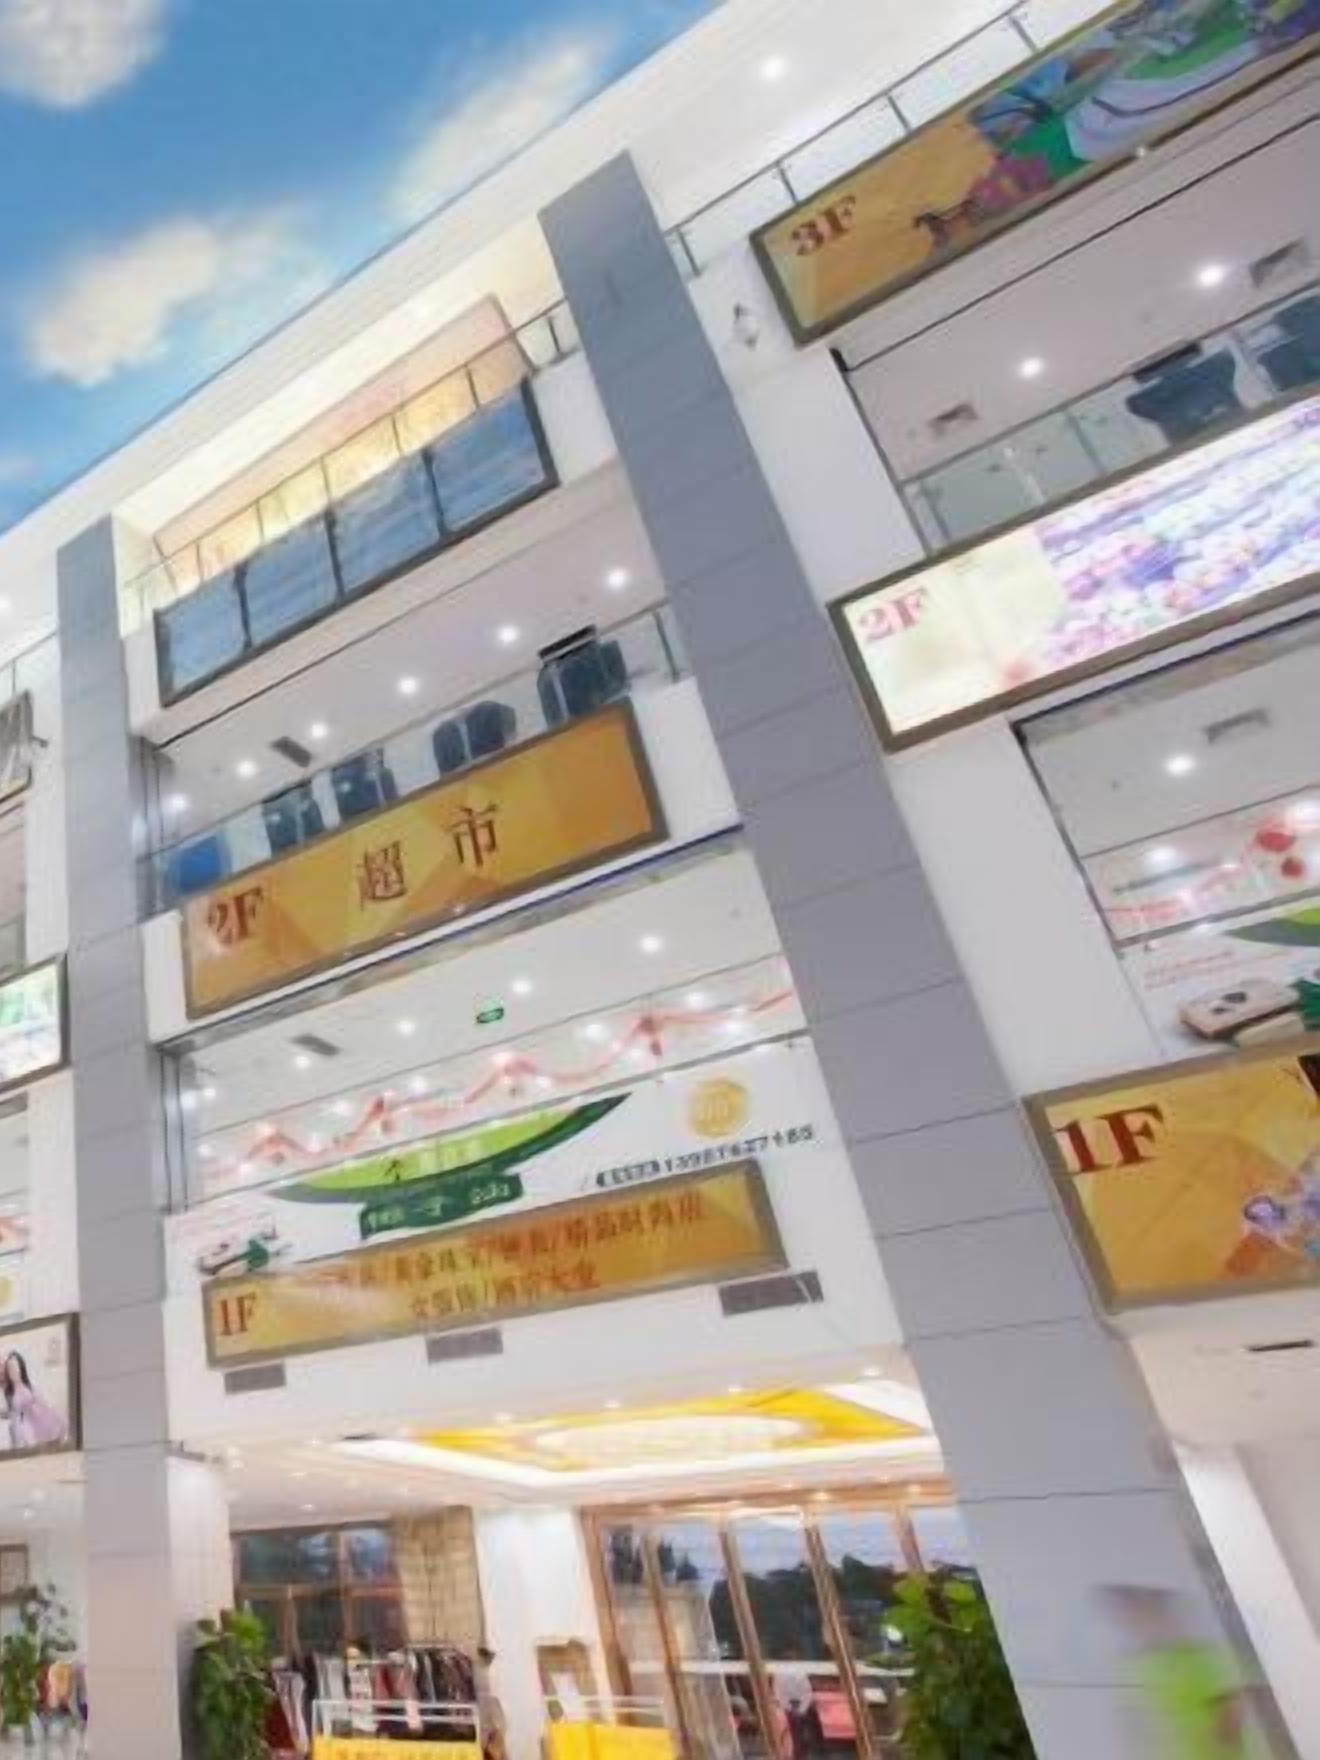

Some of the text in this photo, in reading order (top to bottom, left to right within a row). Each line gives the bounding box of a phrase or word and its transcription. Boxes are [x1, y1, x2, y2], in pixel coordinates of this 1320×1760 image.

[791, 195, 857, 256] 3F
[858, 586, 928, 642] 2F
[354, 804, 498, 912] 超市
[207, 886, 264, 944] 2F
[1055, 1102, 1164, 1174] 1F
[220, 1291, 257, 1336] 1F
